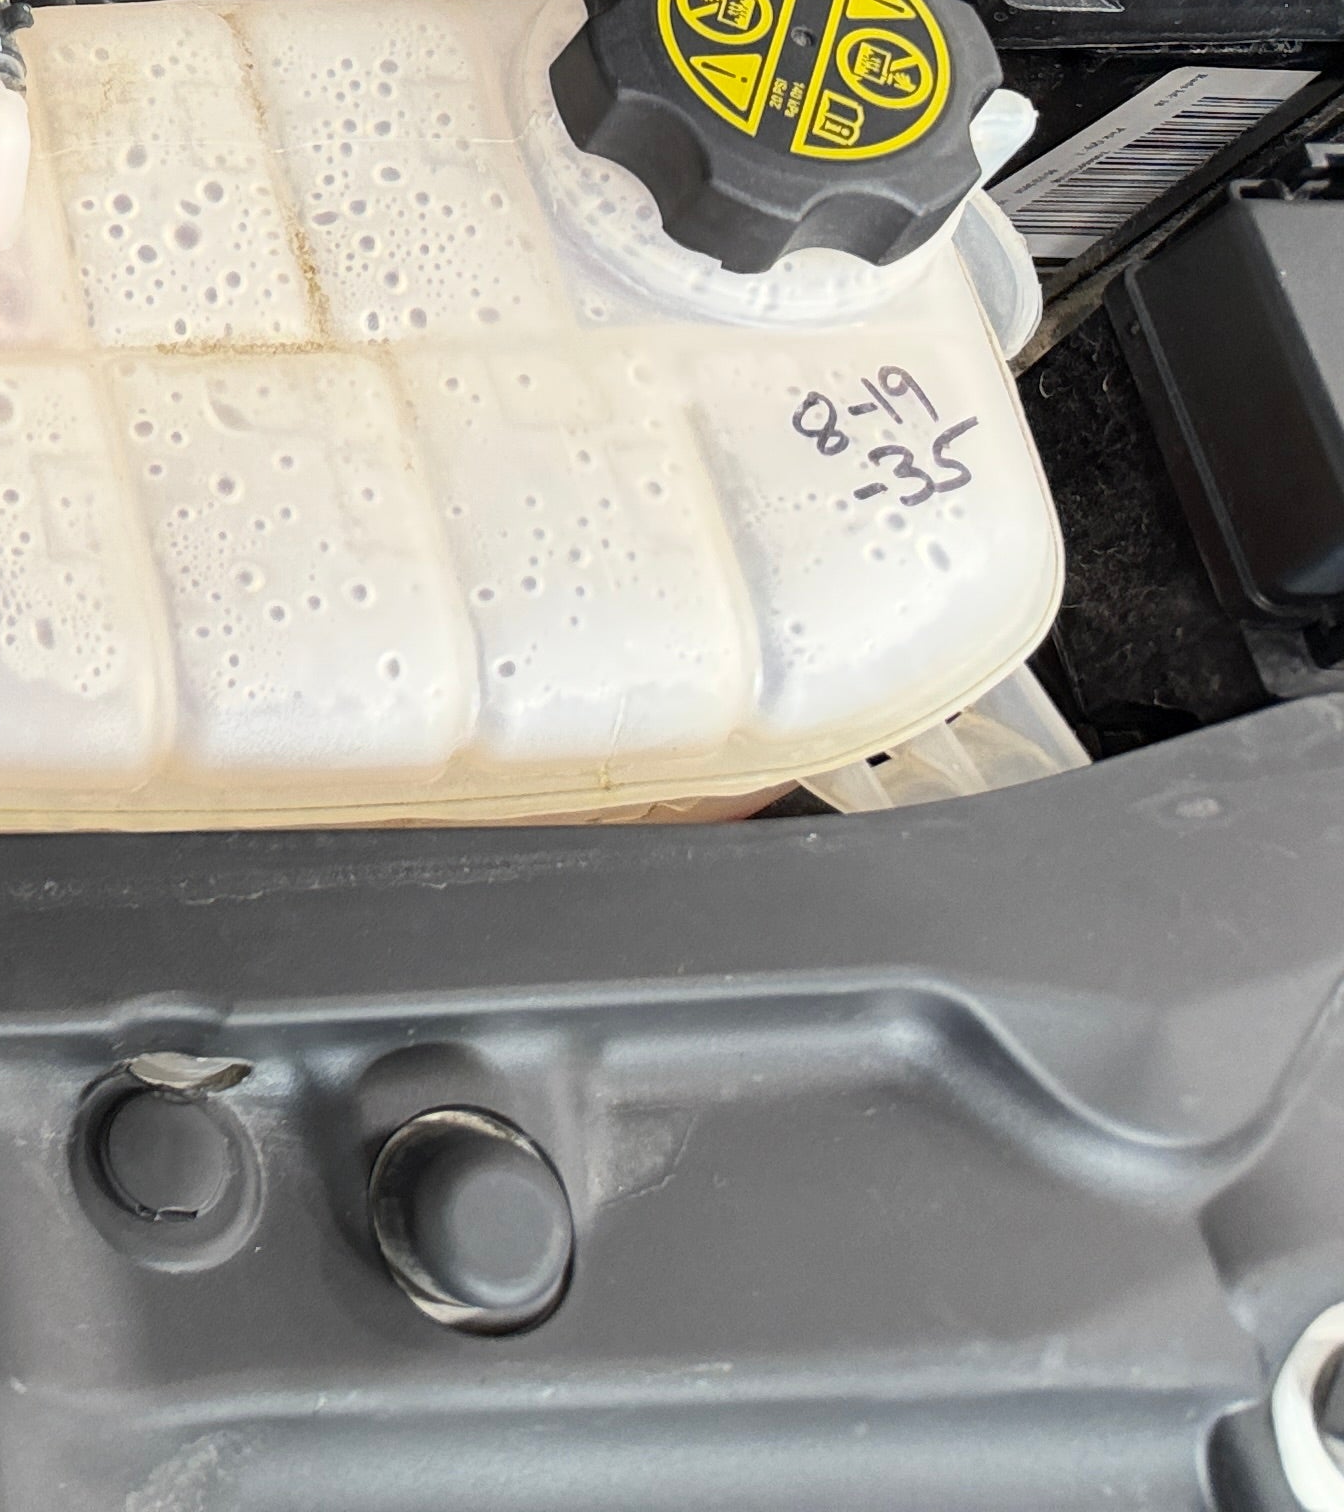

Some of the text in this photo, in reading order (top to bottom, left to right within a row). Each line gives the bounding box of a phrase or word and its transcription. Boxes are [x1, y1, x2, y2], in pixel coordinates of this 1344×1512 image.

[769, 77, 788, 110] 20 PSI
[791, 365, 940, 456] 8-19
[853, 415, 980, 507] -35
